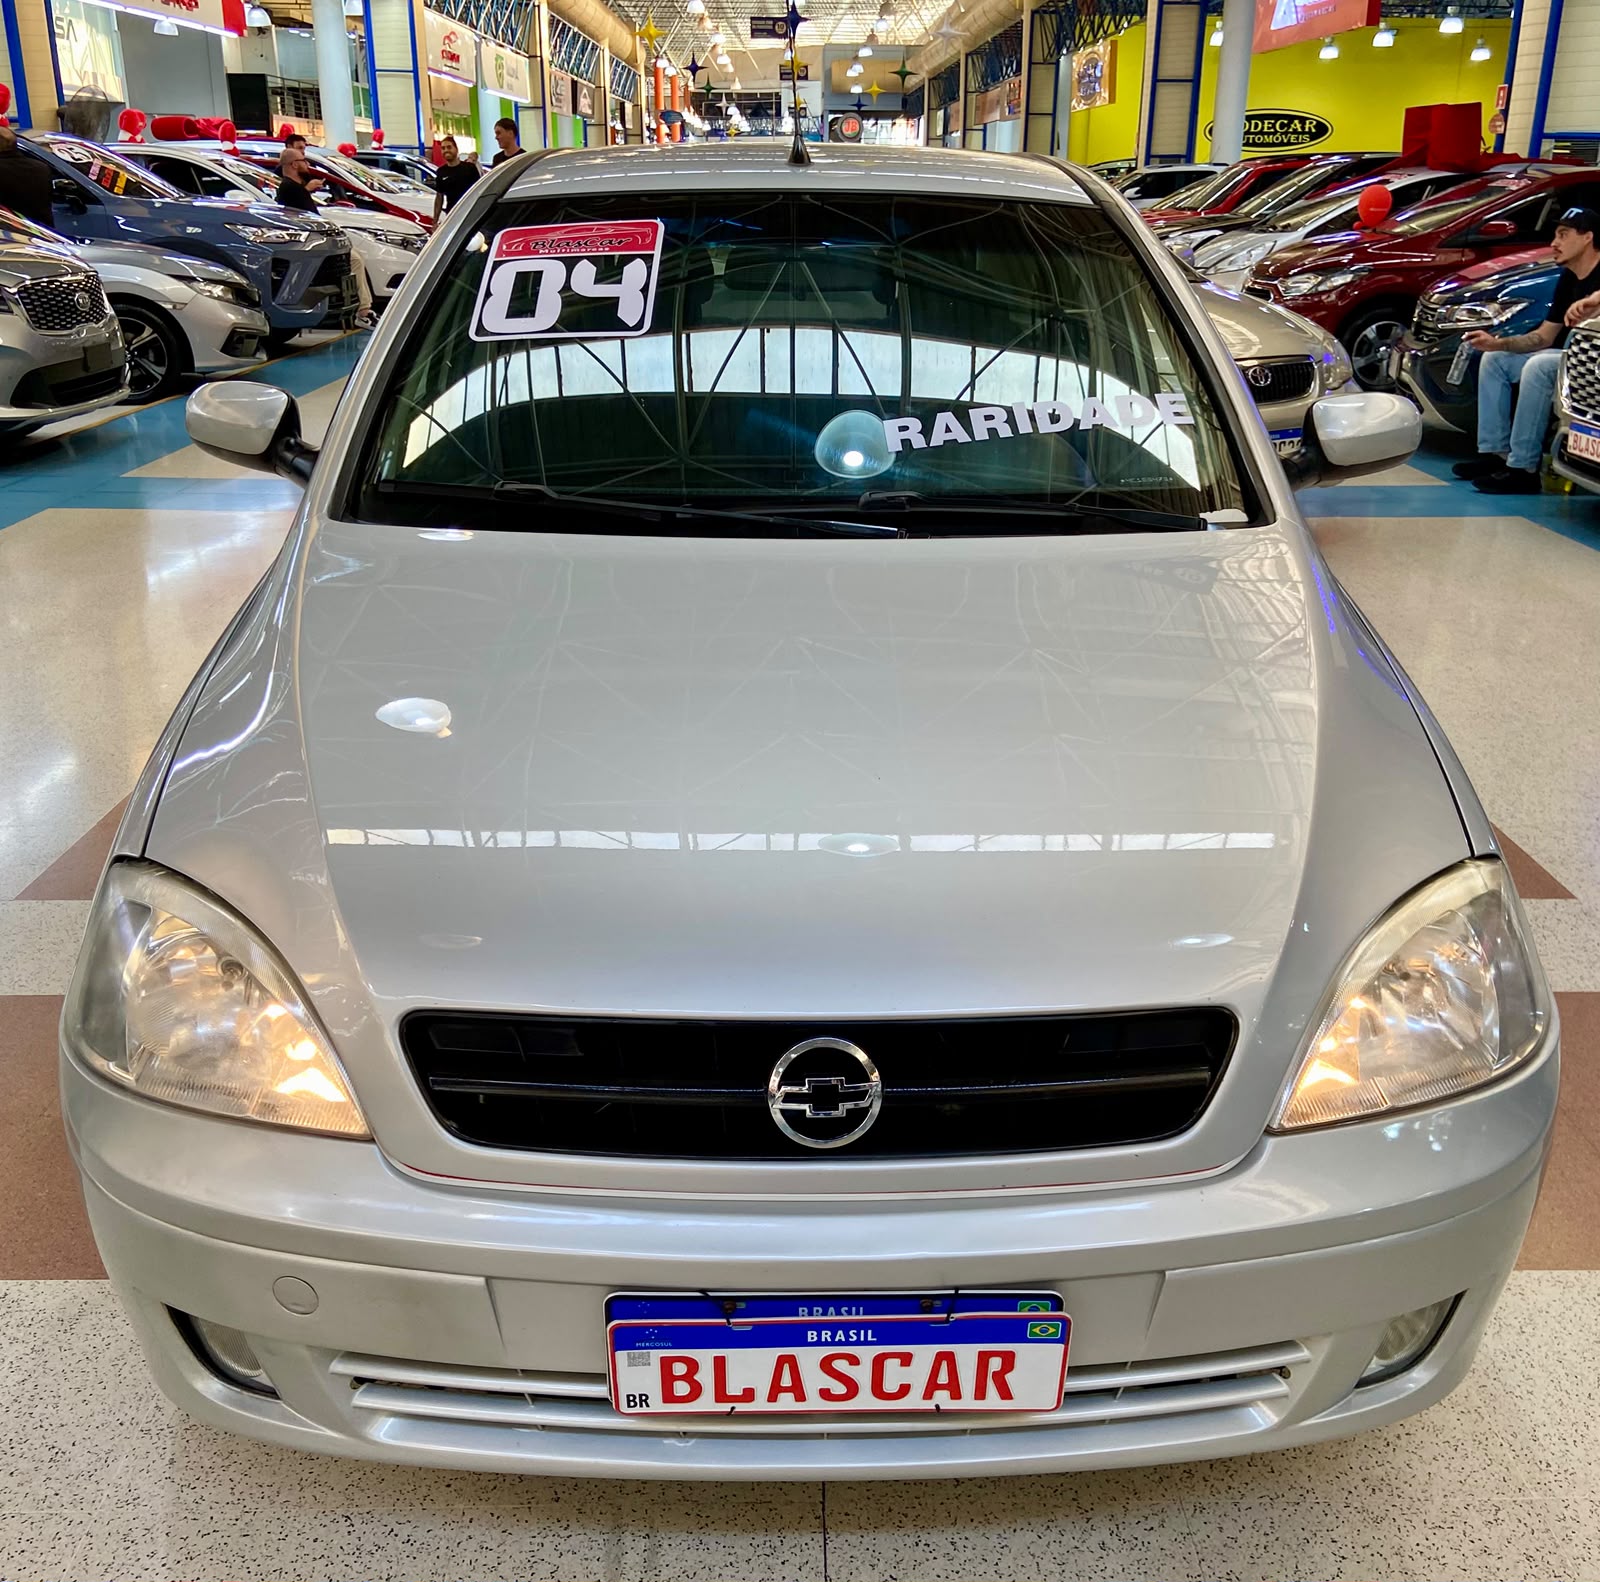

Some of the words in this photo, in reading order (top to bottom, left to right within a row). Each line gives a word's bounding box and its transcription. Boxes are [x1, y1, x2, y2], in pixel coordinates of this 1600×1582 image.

[481, 258, 648, 334] 04
[882, 393, 1196, 453] RARIDADE
[807, 1329, 878, 1342] BRASIL
[625, 1393, 651, 1408] BR
[659, 1349, 1017, 1405] BLASCAR
